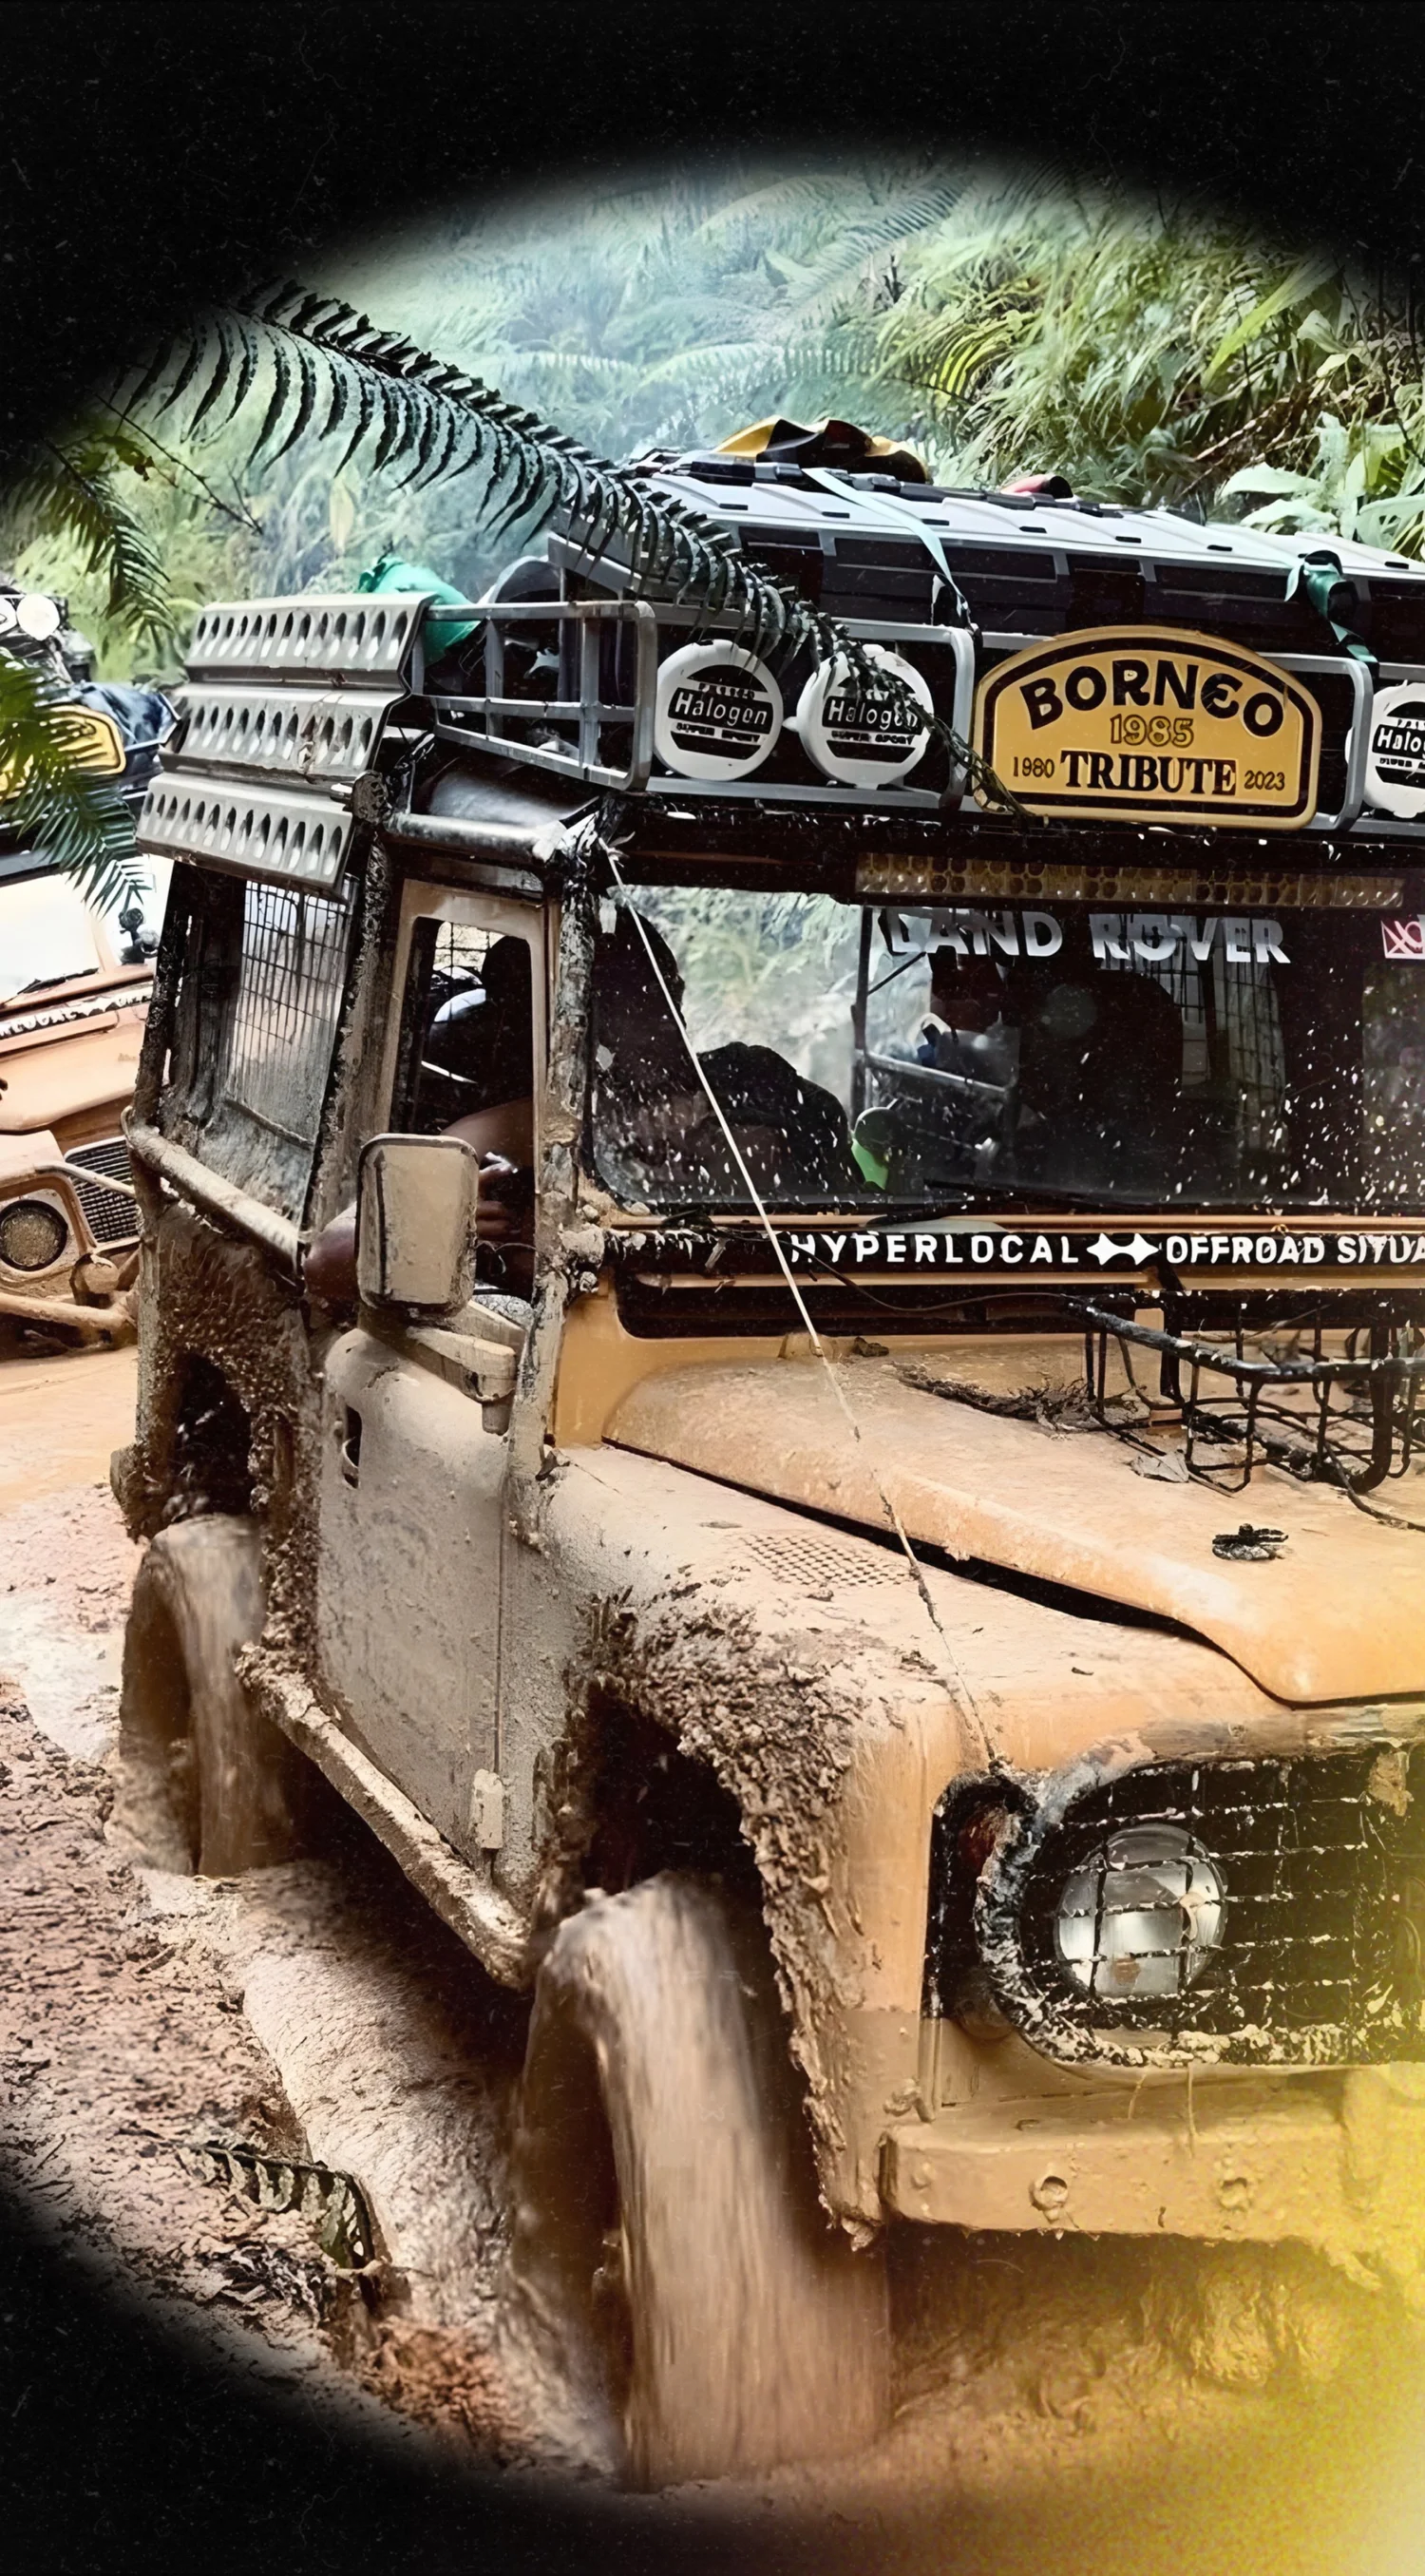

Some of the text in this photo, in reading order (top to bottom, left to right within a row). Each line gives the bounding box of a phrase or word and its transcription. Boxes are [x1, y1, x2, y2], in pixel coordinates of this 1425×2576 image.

[674, 691, 768, 726] Halogen
[1019, 658, 1284, 737] BORNEO
[1110, 714, 1194, 747] 1985
[1377, 727, 1425, 759] Halo
[1012, 749, 1285, 796] 1980 TRIBUTE 2023
[884, 908, 1291, 964] LAND ROVER
[790, 1233, 1078, 1264] HYPERLOCAL
[1166, 1234, 1325, 1265] OFFROAD
